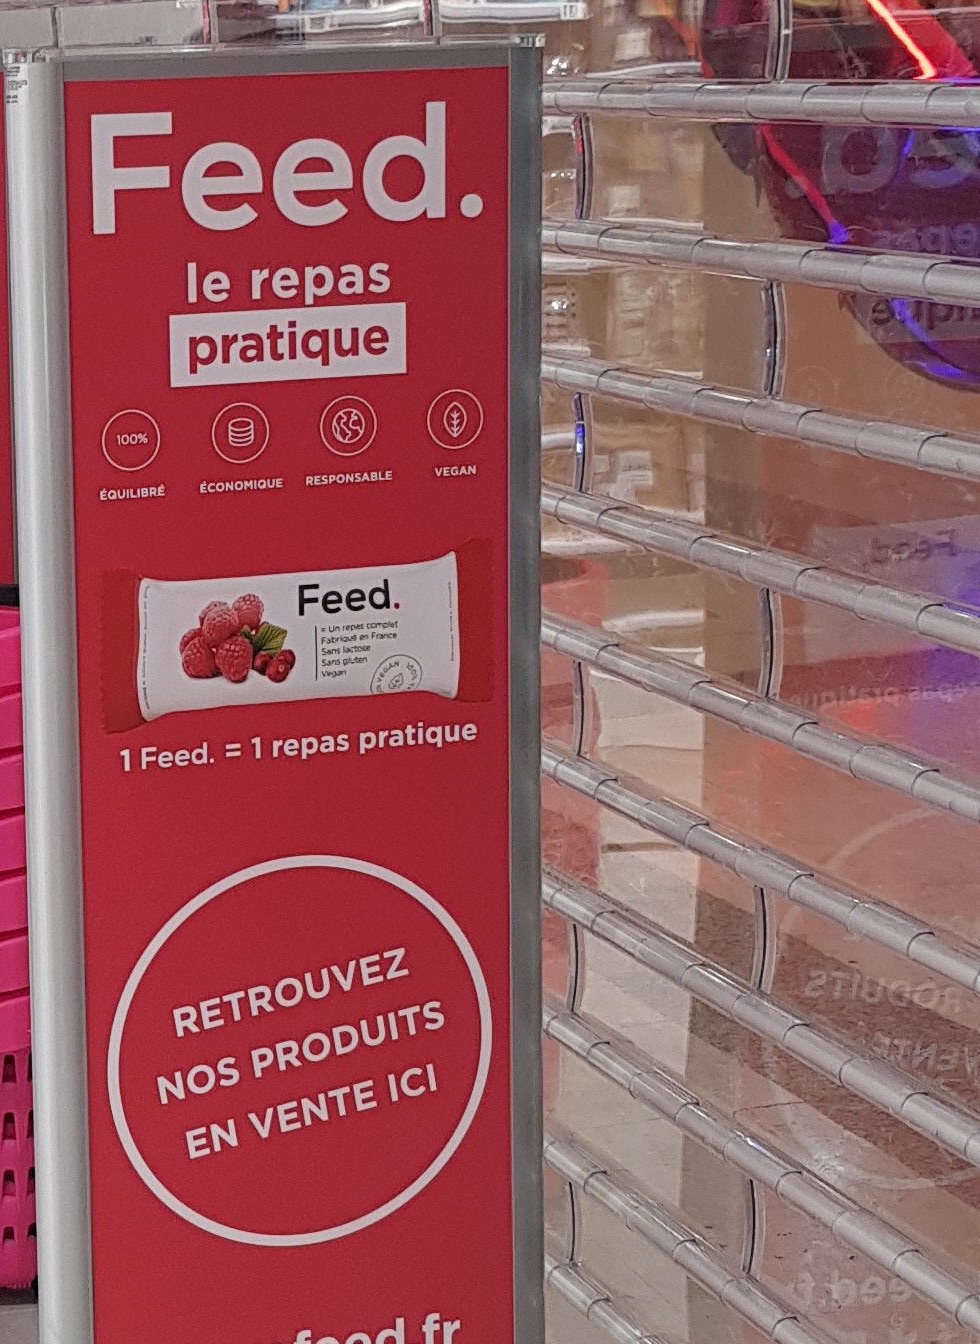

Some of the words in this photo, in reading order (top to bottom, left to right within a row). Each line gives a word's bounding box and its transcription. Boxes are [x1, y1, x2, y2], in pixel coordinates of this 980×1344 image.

[89, 100, 485, 236] Feed.
[187, 261, 231, 304] le
[250, 262, 391, 306] repas
[188, 320, 390, 375] pratique
[116, 432, 149, 447] 100%
[305, 469, 393, 487] RESPONSABLE
[434, 464, 477, 478] VEGAN
[99, 483, 166, 502] ÉQUILIBRÉ
[199, 477, 284, 495] ÉCONOMIQUE
[298, 578, 400, 617] Feed.
[328, 625, 341, 633] Un
[342, 623, 365, 634] repas
[321, 634, 357, 646] Fabriqué
[371, 631, 398, 641] France
[321, 647, 341, 656] Sans
[342, 644, 371, 654] lactose
[321, 658, 341, 668] Sans
[342, 656, 368, 667] gluten
[321, 669, 348, 679] Vegan
[119, 748, 131, 772] 1
[140, 742, 216, 770] Feed.
[224, 742, 242, 758] =
[251, 737, 263, 760] 1
[272, 731, 351, 760] repas
[359, 721, 479, 754] pratique
[172, 947, 410, 1038] RETROUVEZ
[156, 1056, 241, 1105] NOS
[250, 1001, 446, 1079] PRODUITS
[185, 1118, 239, 1160] EN
[247, 1079, 378, 1139] VENTE
[386, 1063, 438, 1102] ICI
